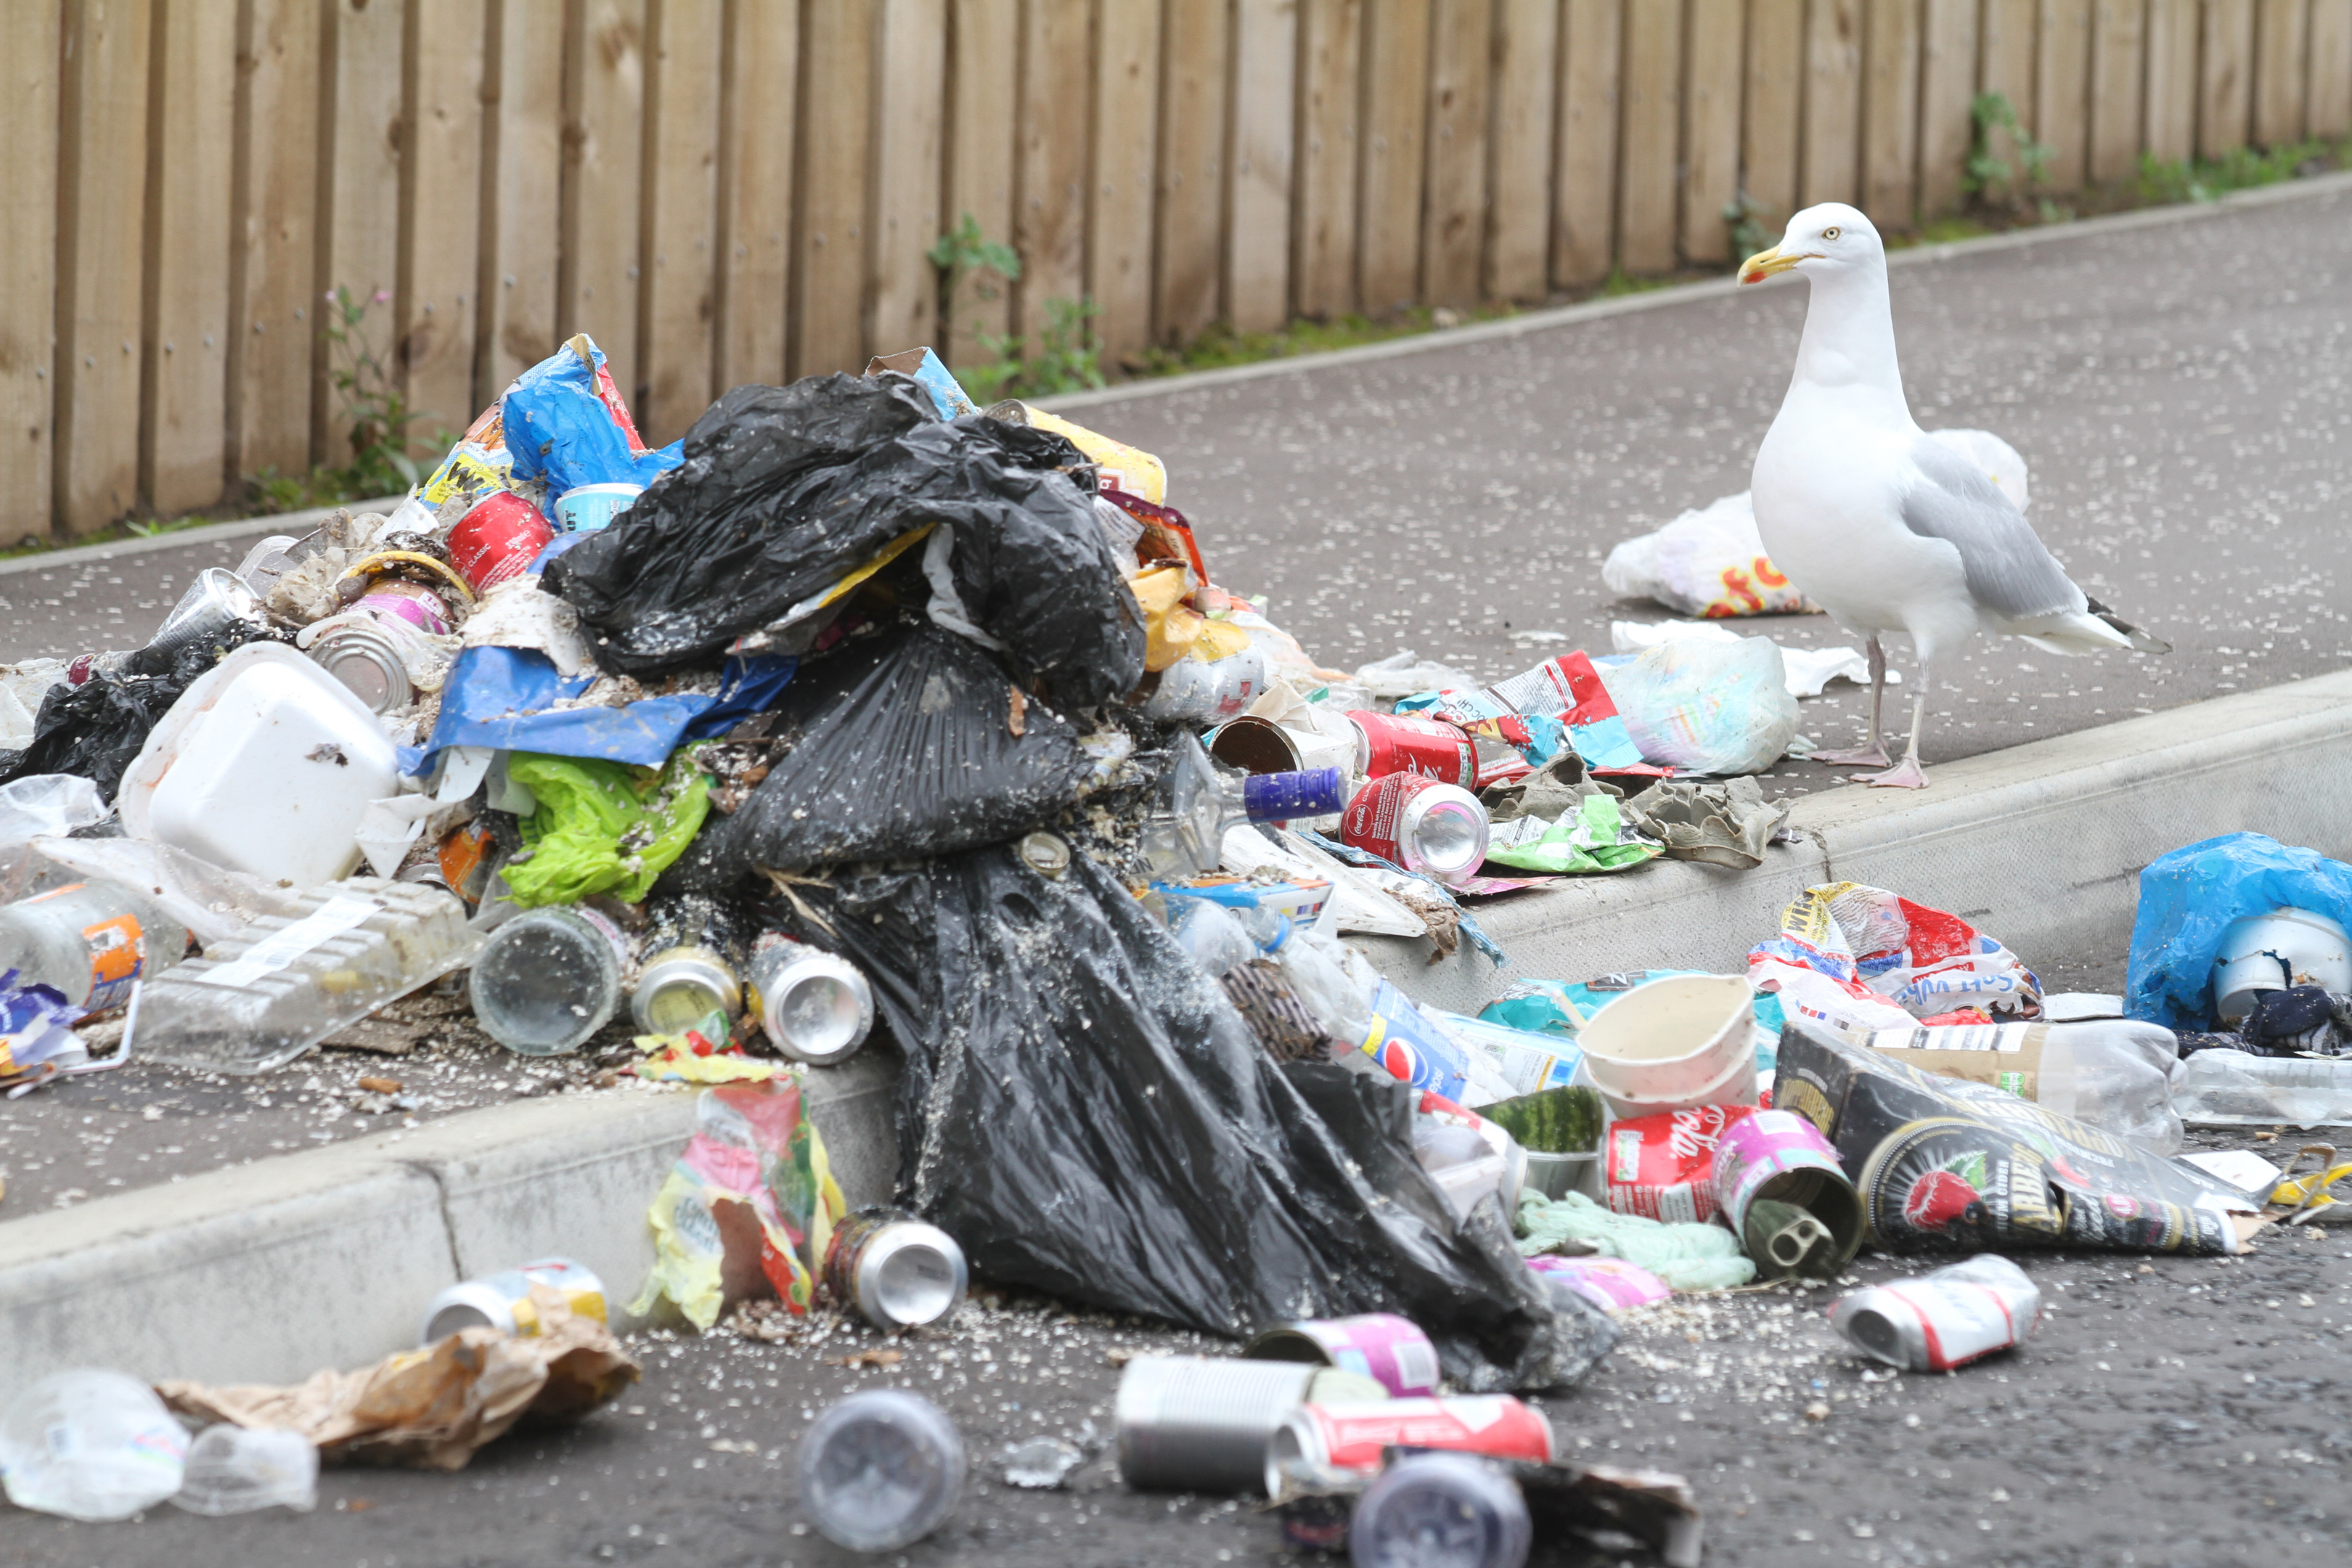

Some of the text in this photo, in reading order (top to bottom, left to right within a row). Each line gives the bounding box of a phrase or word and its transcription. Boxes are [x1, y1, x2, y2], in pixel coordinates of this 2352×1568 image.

[467, 543, 491, 568] CLASSIC
[1882, 1150, 1910, 1184] RASPBERRY
[1994, 1159, 2010, 1196] CIDER
